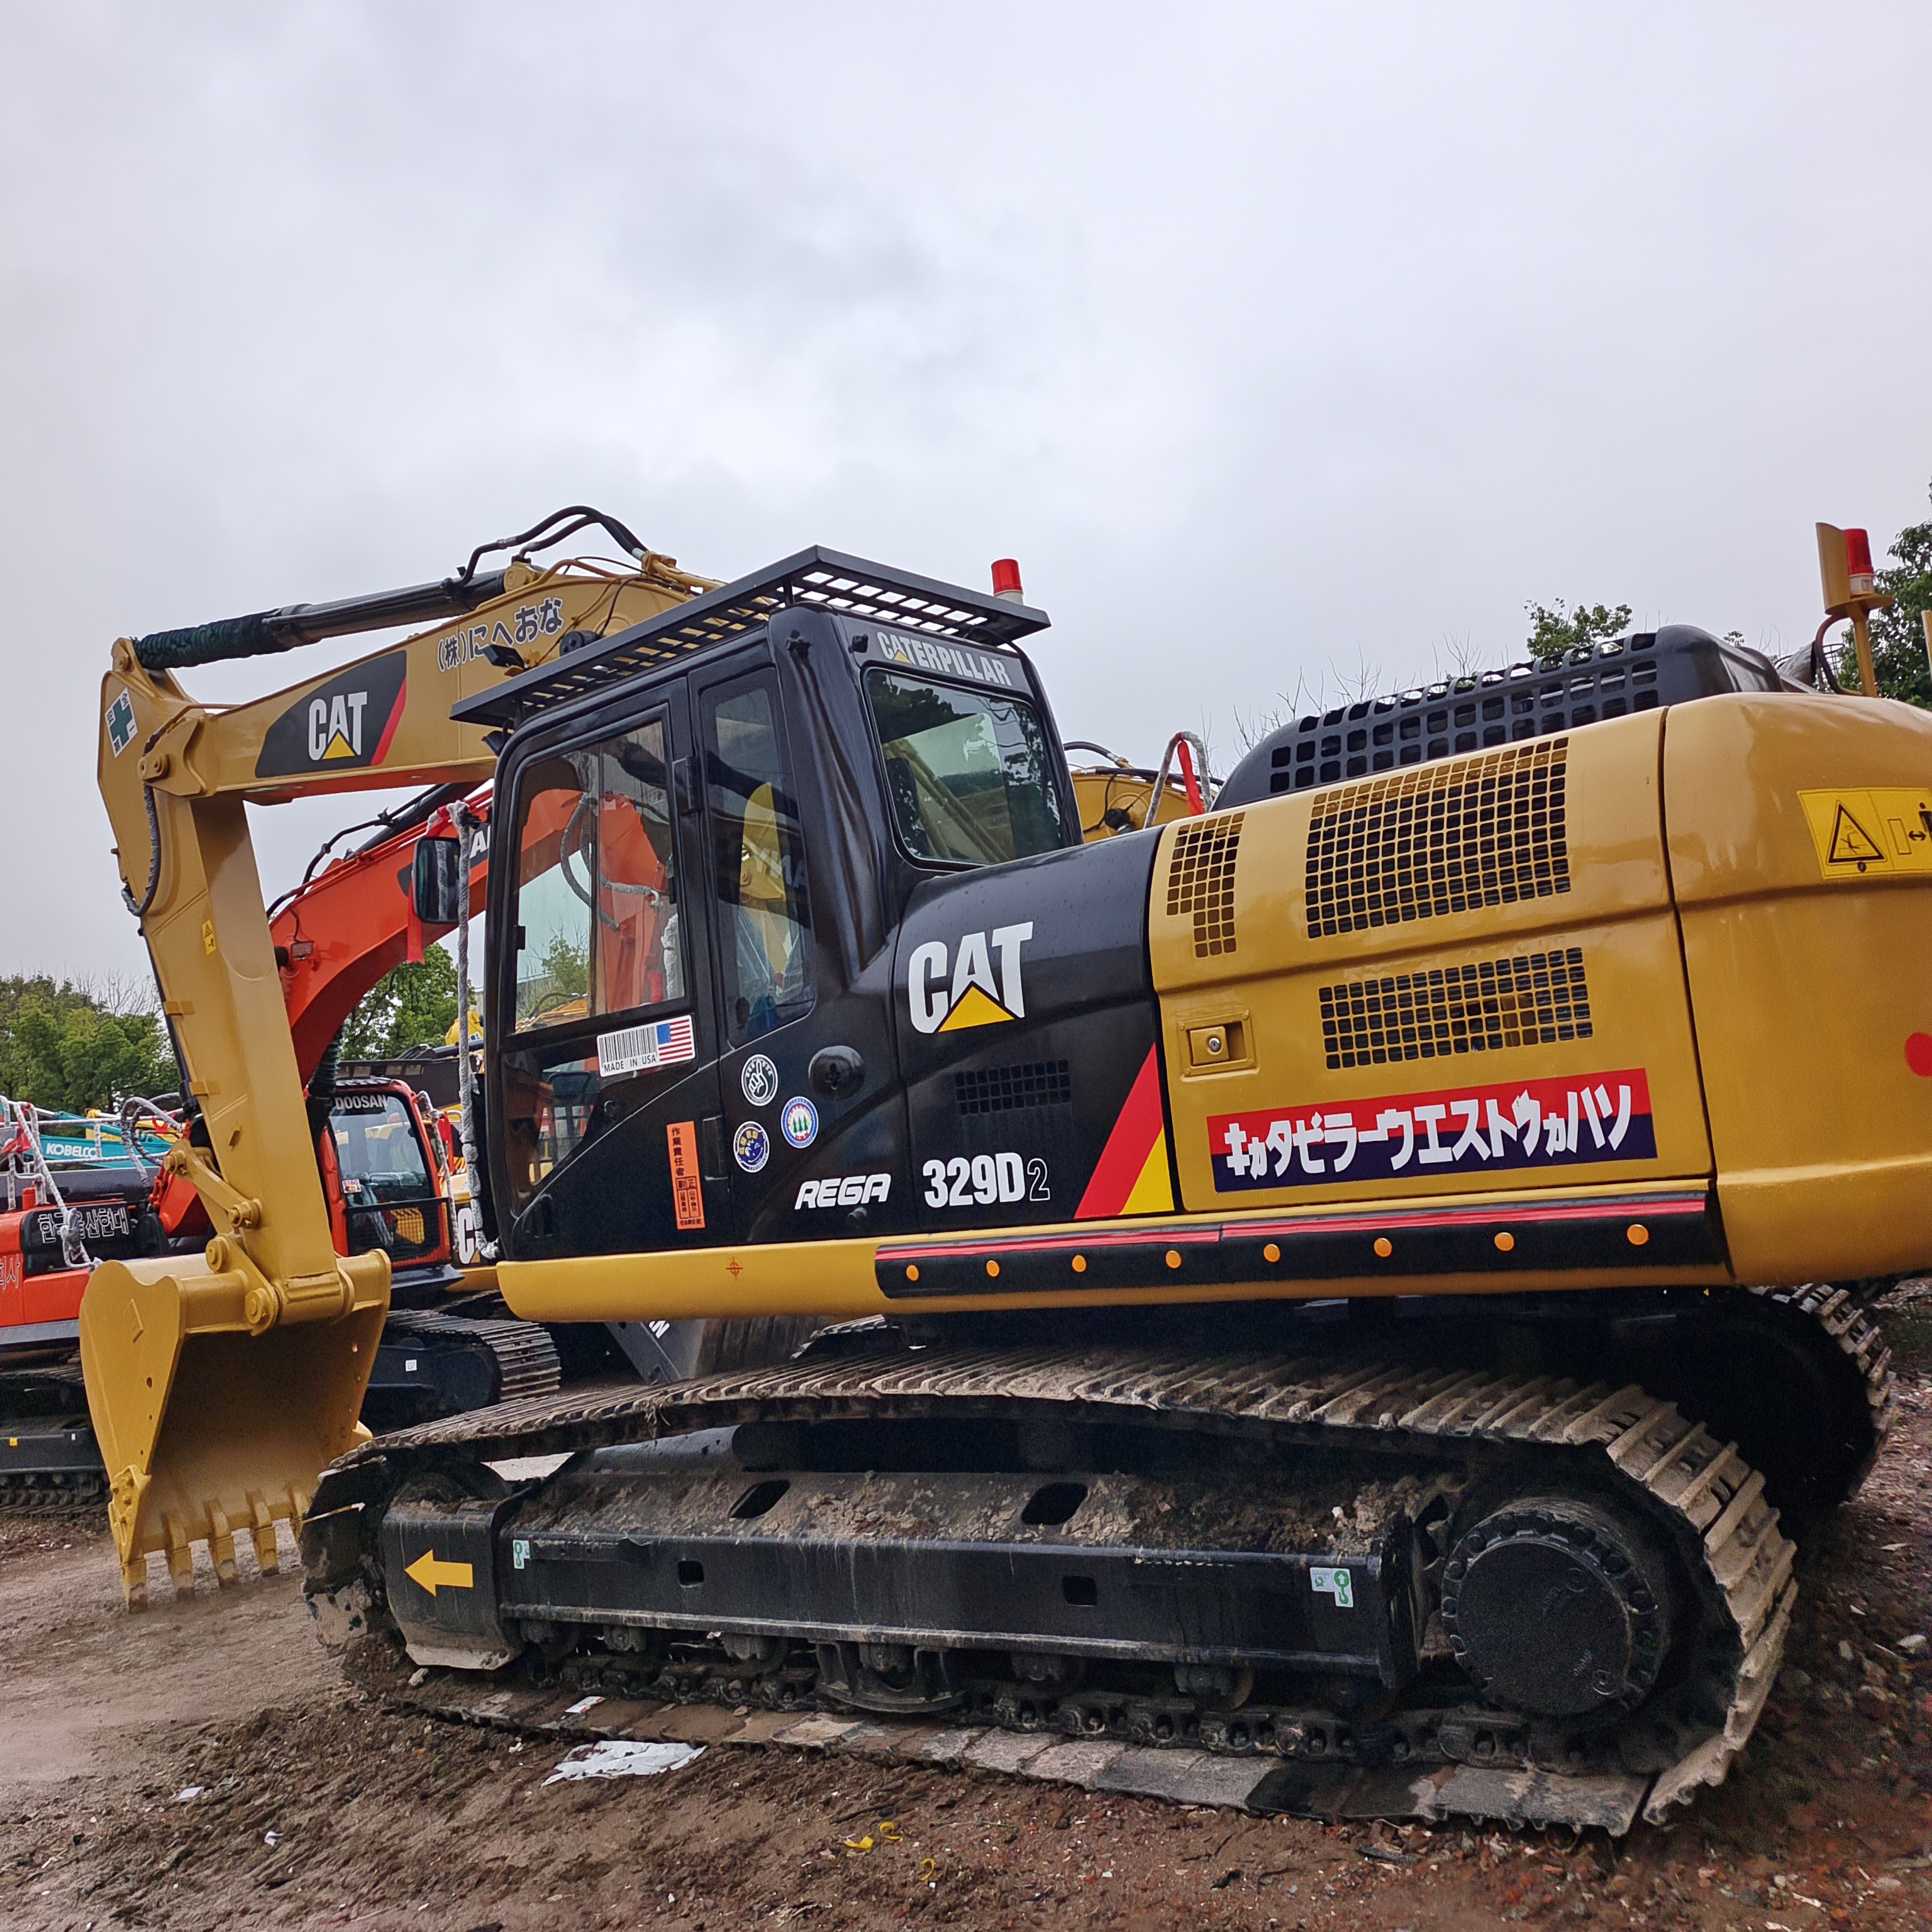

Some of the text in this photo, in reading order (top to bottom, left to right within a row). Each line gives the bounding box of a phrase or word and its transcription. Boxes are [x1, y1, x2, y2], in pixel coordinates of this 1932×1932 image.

[877, 631, 1013, 687] CATERPILLAR
[308, 691, 368, 761] CAT
[909, 921, 1033, 1034] CAT
[604, 1054, 657, 1073] MADE IN USA
[335, 1094, 388, 1111] DOOSAN
[46, 1142, 97, 1158] KOBELCO
[794, 1173, 892, 1210] REGA
